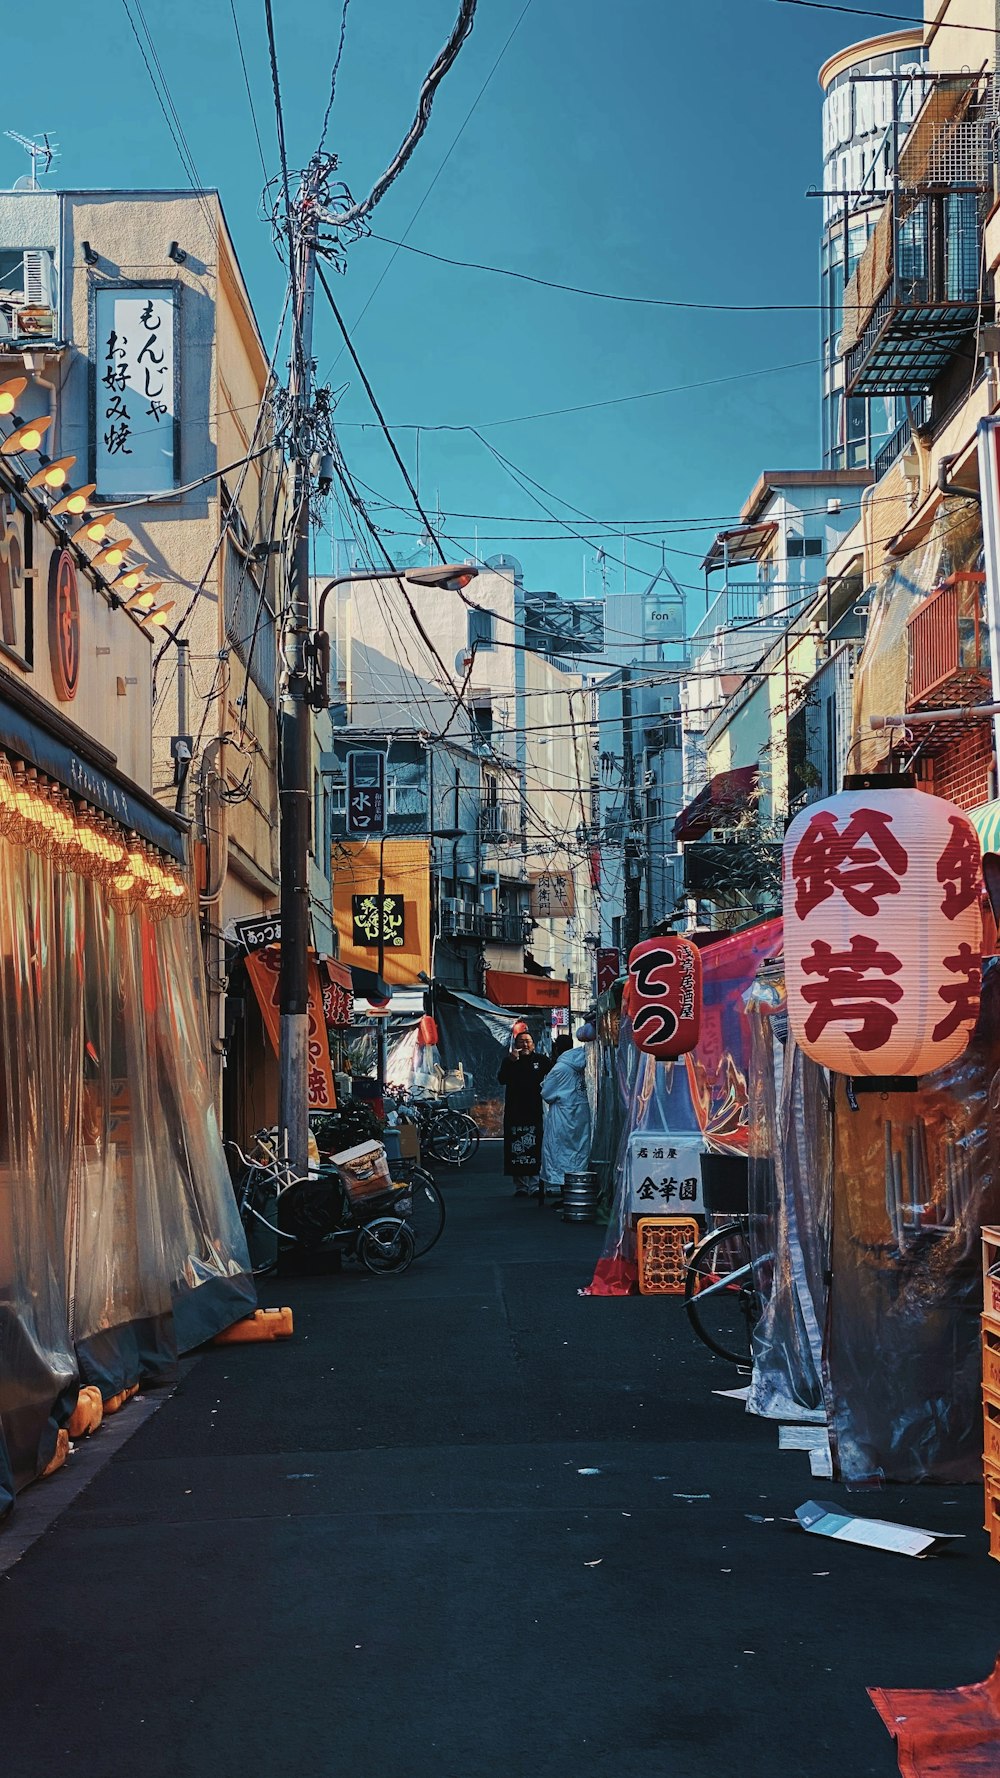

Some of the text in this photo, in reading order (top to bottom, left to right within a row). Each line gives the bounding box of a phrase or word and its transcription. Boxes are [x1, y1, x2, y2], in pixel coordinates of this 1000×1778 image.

[136, 300, 169, 423] もんじゃ
[102, 330, 133, 456] お好み焼
[651, 611, 669, 621] fon
[352, 791, 371, 827] 水口
[537, 875, 551, 916] 肉衛門
[793, 808, 908, 1051] 鈴芳
[629, 948, 678, 1046] てつ
[677, 944, 695, 1020] 浅草居酒屋
[637, 1147, 678, 1159] 居酒屋
[636, 1176, 698, 1204] 金華園
